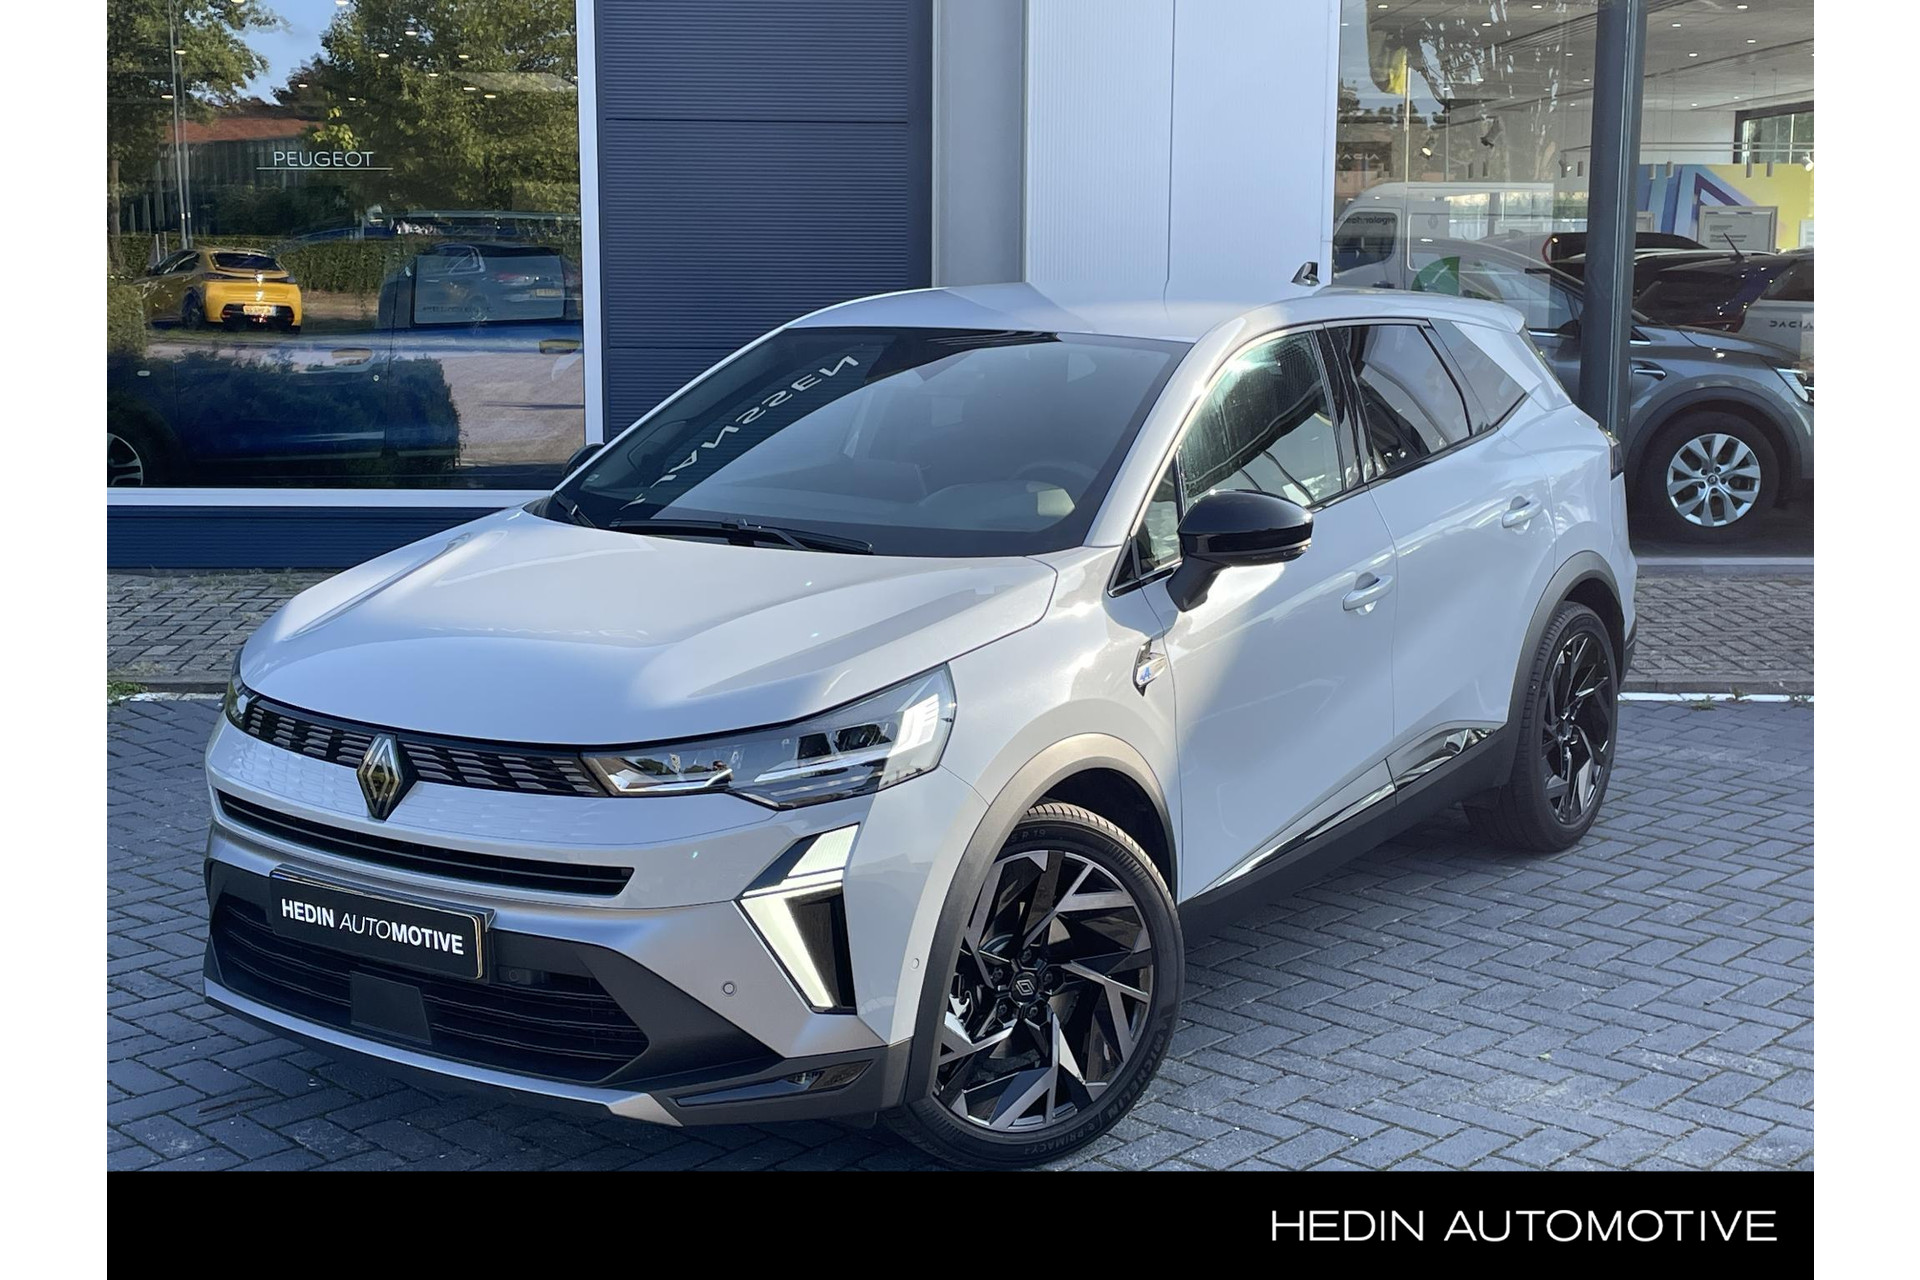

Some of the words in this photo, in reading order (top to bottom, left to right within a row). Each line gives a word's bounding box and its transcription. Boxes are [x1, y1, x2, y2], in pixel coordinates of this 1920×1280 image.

[273, 151, 374, 167] PEUGEOT
[281, 898, 335, 928] HEDIN
[339, 912, 464, 955] AUTOMOTIVE
[1107, 1032, 1165, 1119] MICHELIN
